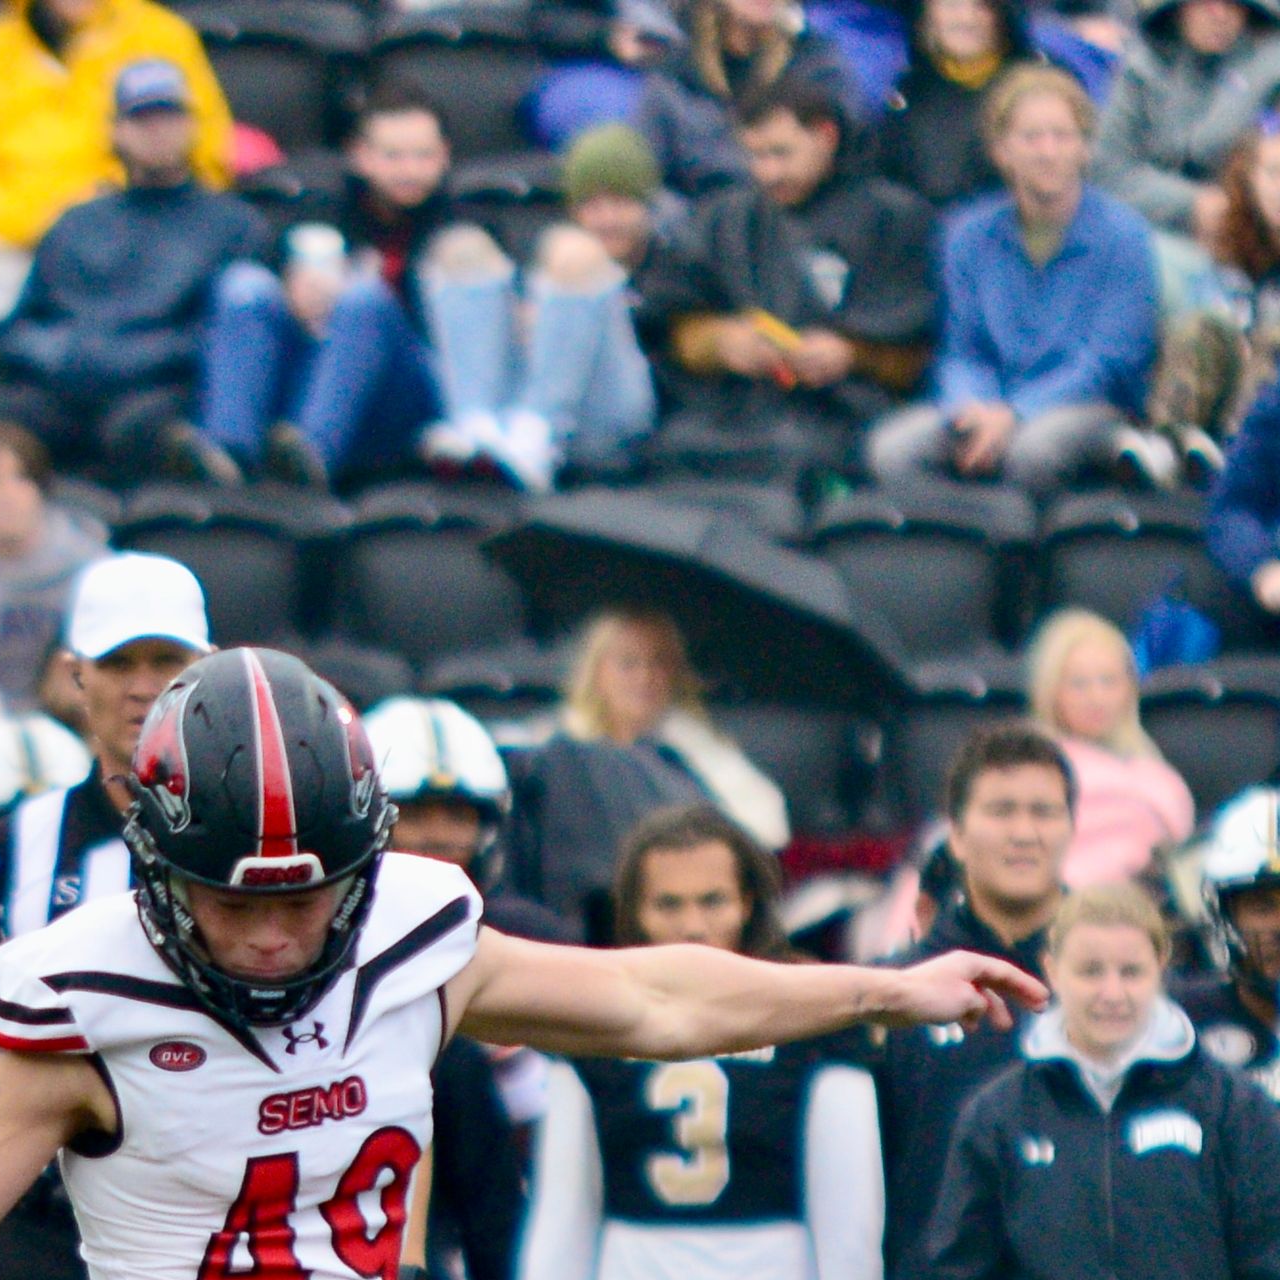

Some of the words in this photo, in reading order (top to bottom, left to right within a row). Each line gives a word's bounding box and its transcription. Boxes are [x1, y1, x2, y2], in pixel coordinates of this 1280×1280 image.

[54, 876, 81, 904] S
[161, 1051, 193, 1062] OVC
[258, 1076, 367, 1135] SEMO
[648, 1060, 730, 1207] 3
